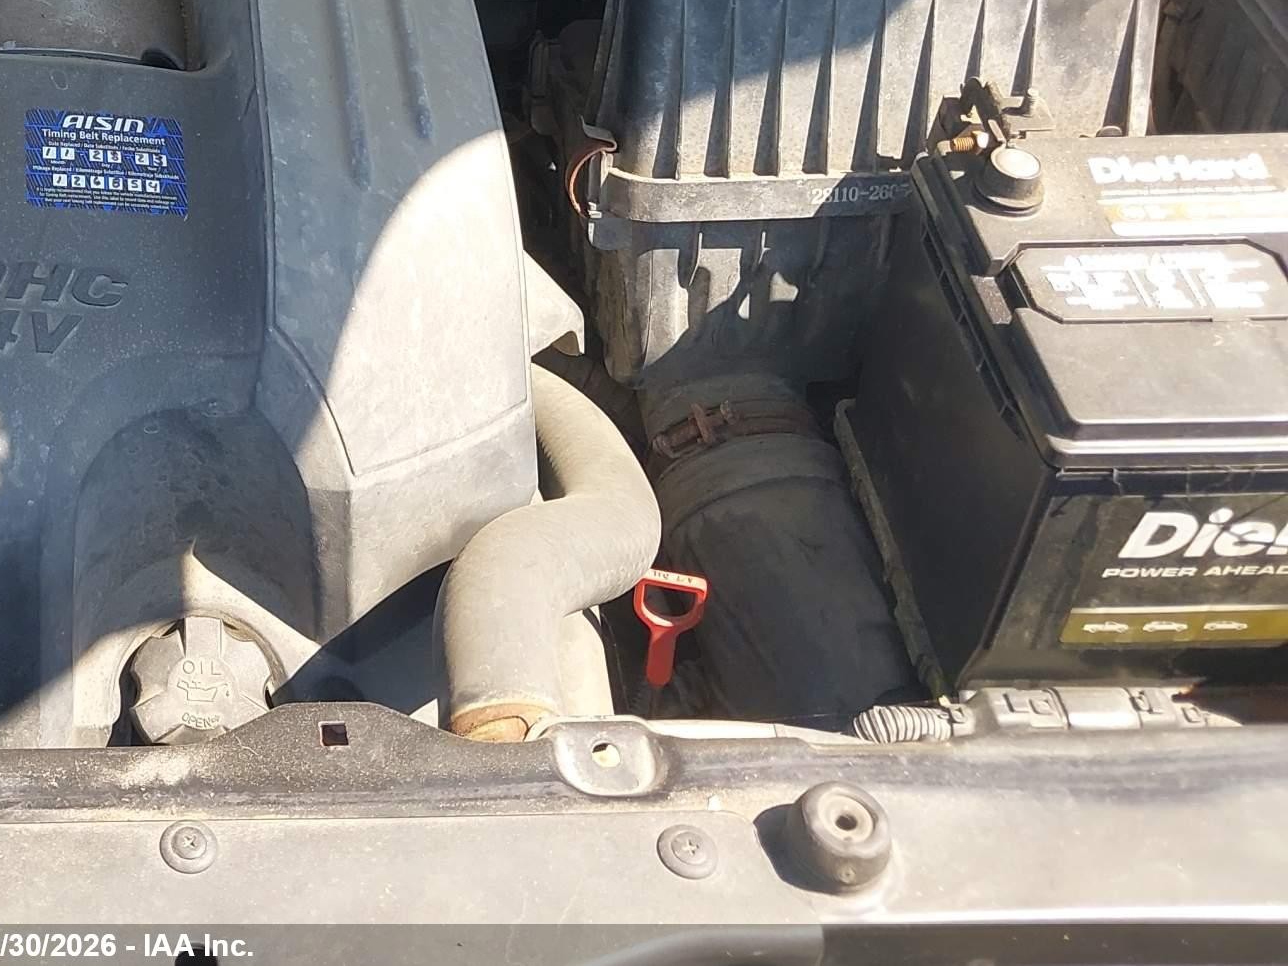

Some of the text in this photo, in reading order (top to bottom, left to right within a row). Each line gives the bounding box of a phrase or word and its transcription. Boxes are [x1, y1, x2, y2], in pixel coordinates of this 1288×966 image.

[63, 114, 144, 133] AISIN
[42, 128, 166, 146] Timing Belt Replacement
[1088, 153, 1272, 184] DieHard
[1117, 507, 1288, 559] Die
[1102, 566, 1197, 579] POWER
[182, 659, 222, 676] OIL
